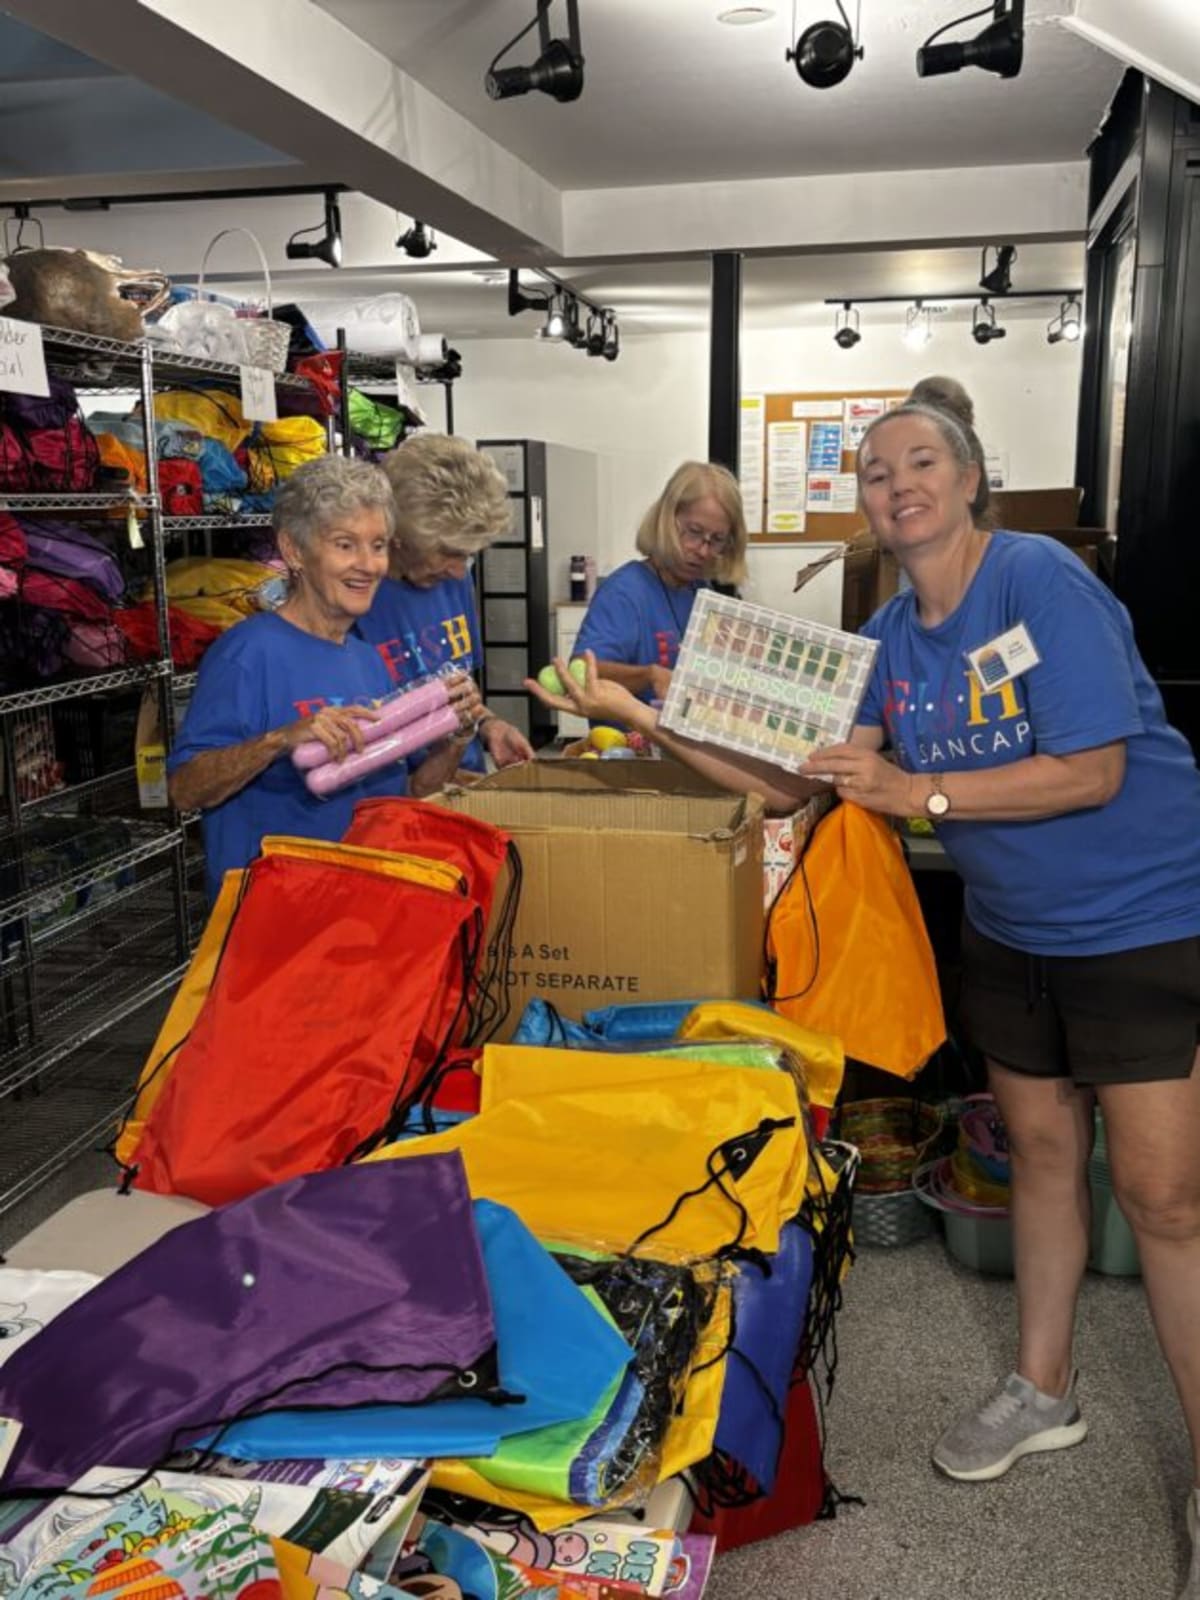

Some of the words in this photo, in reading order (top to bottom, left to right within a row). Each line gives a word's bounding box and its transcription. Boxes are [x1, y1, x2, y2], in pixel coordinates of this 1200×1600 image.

[919, 721, 1030, 764] SANCAP
[521, 944, 535, 959] A
[539, 944, 570, 961] Set
[535, 972, 640, 993] SEPARATE
